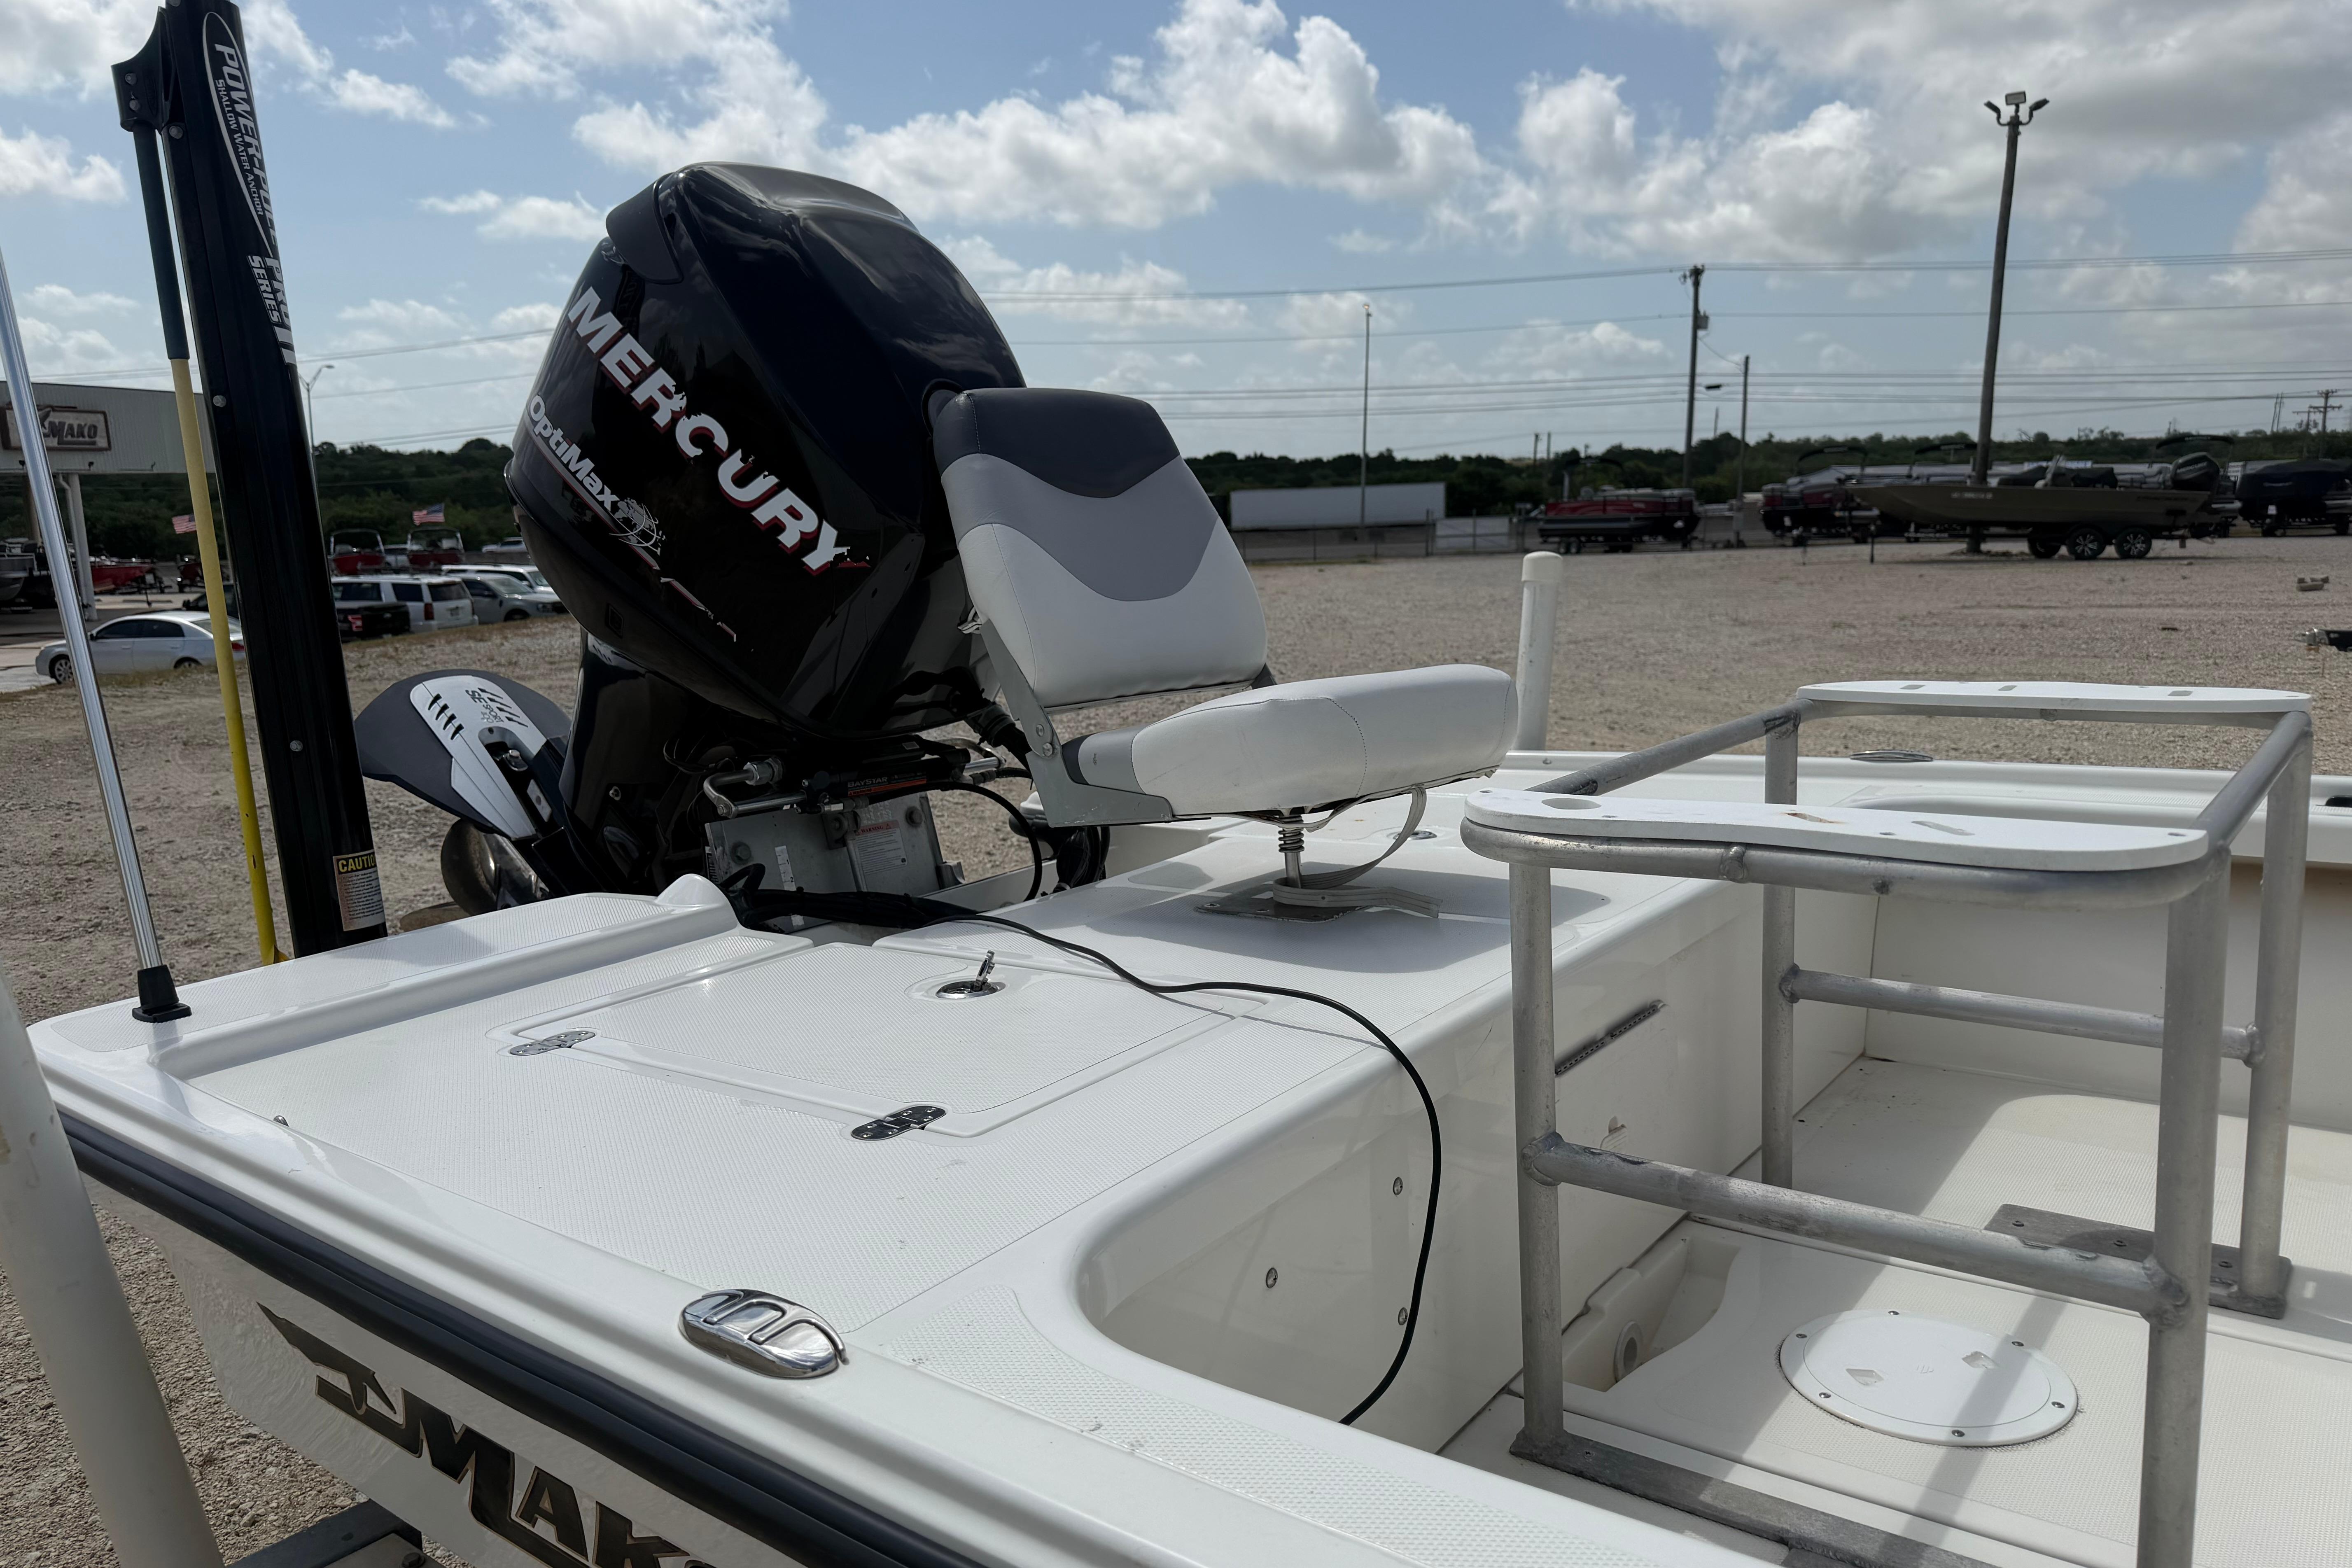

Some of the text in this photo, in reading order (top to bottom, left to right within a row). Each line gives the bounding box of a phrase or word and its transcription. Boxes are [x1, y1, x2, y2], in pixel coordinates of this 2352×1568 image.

[215, 44, 276, 245] POWER-POLE
[215, 79, 264, 215] SHALLOW WATER ANCHOR
[248, 255, 282, 323] SERIES
[265, 257, 291, 329] PRO
[42, 421, 98, 445] MAKO
[530, 394, 620, 511] OptiMax
[567, 287, 856, 572] MERCURY
[465, 690, 488, 703] SE
[483, 704, 504, 723] SPORT
[847, 777, 888, 787] BAYSTAR
[338, 854, 376, 873] CAUTIO
[316, 1375, 717, 1568] MAK
